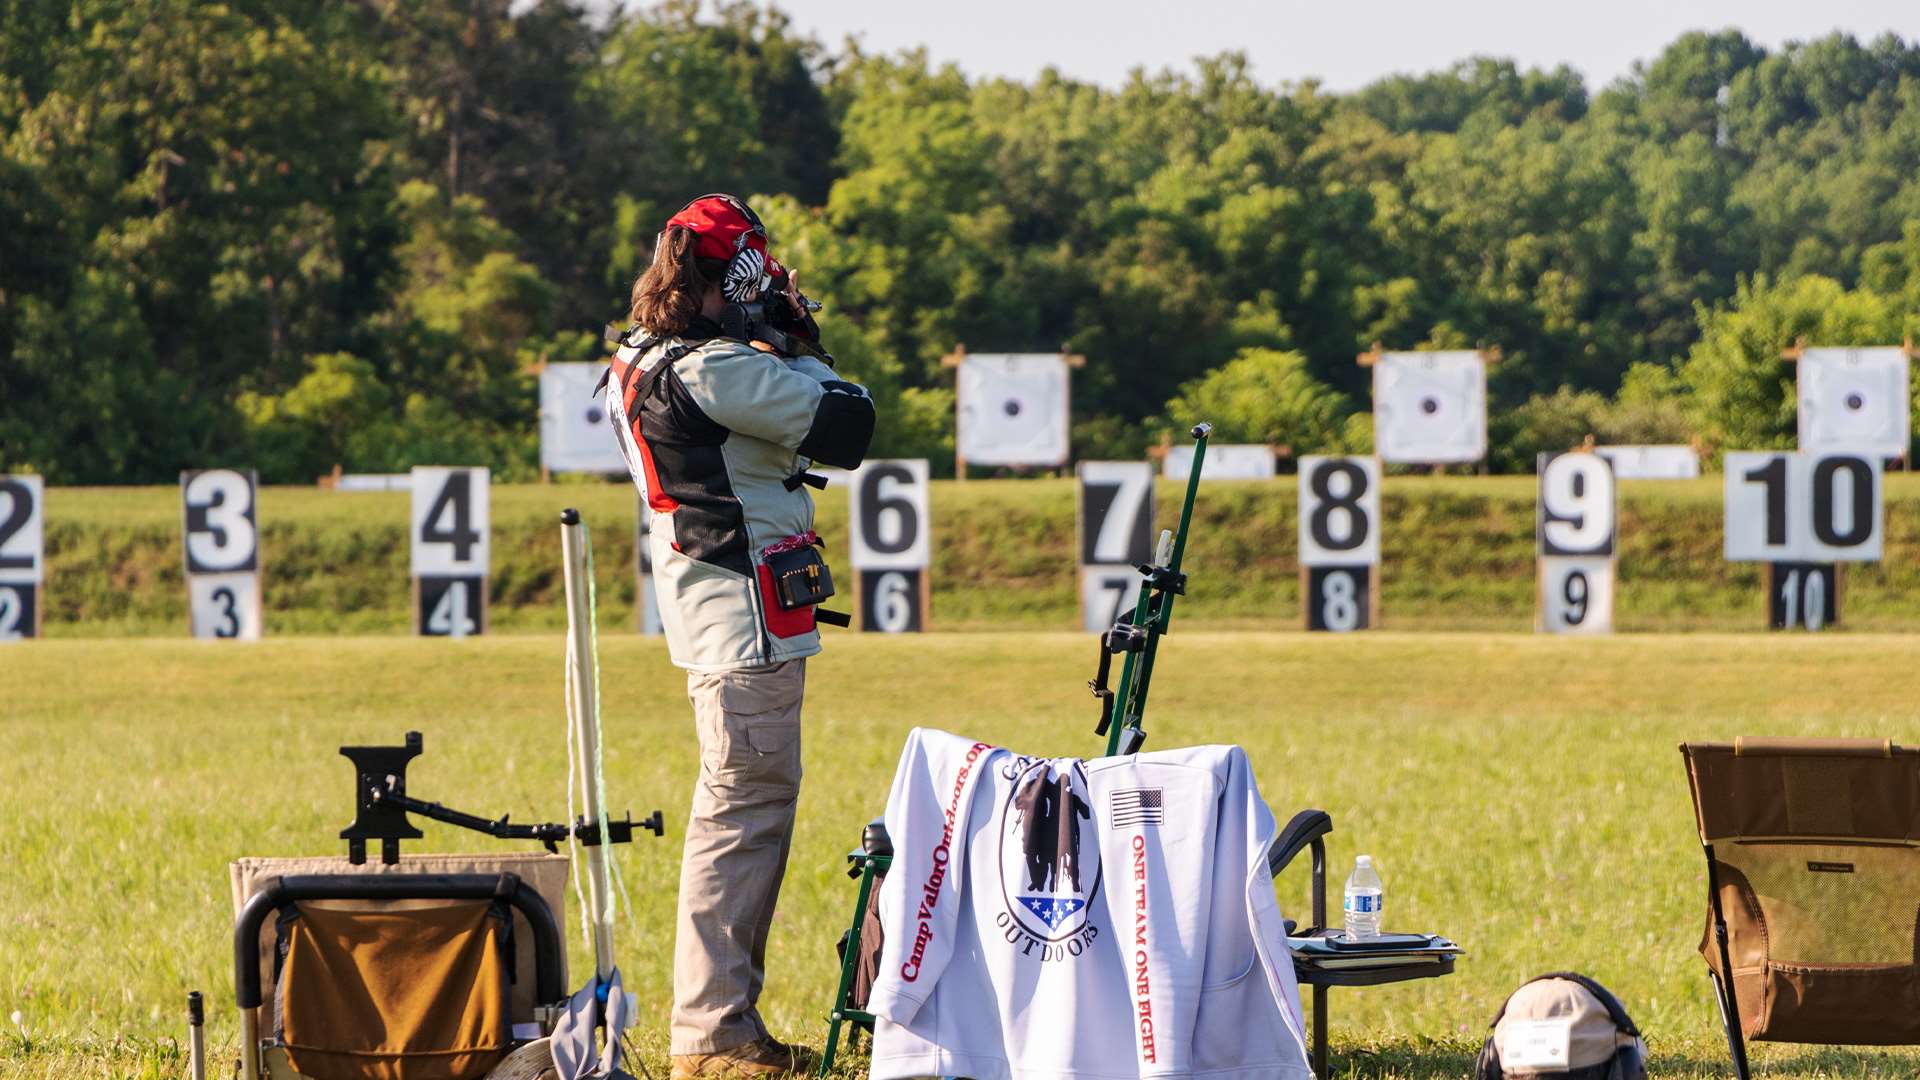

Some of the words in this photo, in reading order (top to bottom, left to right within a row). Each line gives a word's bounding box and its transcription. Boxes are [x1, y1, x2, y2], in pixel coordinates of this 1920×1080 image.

[0, 480, 34, 568] 2
[187, 470, 254, 568] 3
[421, 471, 480, 562] 4
[860, 466, 918, 554] 6
[1080, 462, 1151, 562] 7
[1310, 460, 1369, 550] 8
[1543, 454, 1612, 551] 9
[1745, 457, 1874, 547] 10
[211, 588, 240, 638] 3
[429, 582, 475, 636] 4
[874, 573, 912, 632] 6
[1103, 580, 1128, 632] 7
[1322, 571, 1358, 631] 8
[1564, 570, 1588, 626] 9
[1781, 569, 1825, 631] 10
[901, 742, 992, 983] CampValorOutdoors.or
[1132, 835, 1145, 881] ONE
[996, 911, 1098, 963] OUTDOORS
[1136, 950, 1149, 996] ONE
[1138, 999, 1157, 1065] FIGHT
